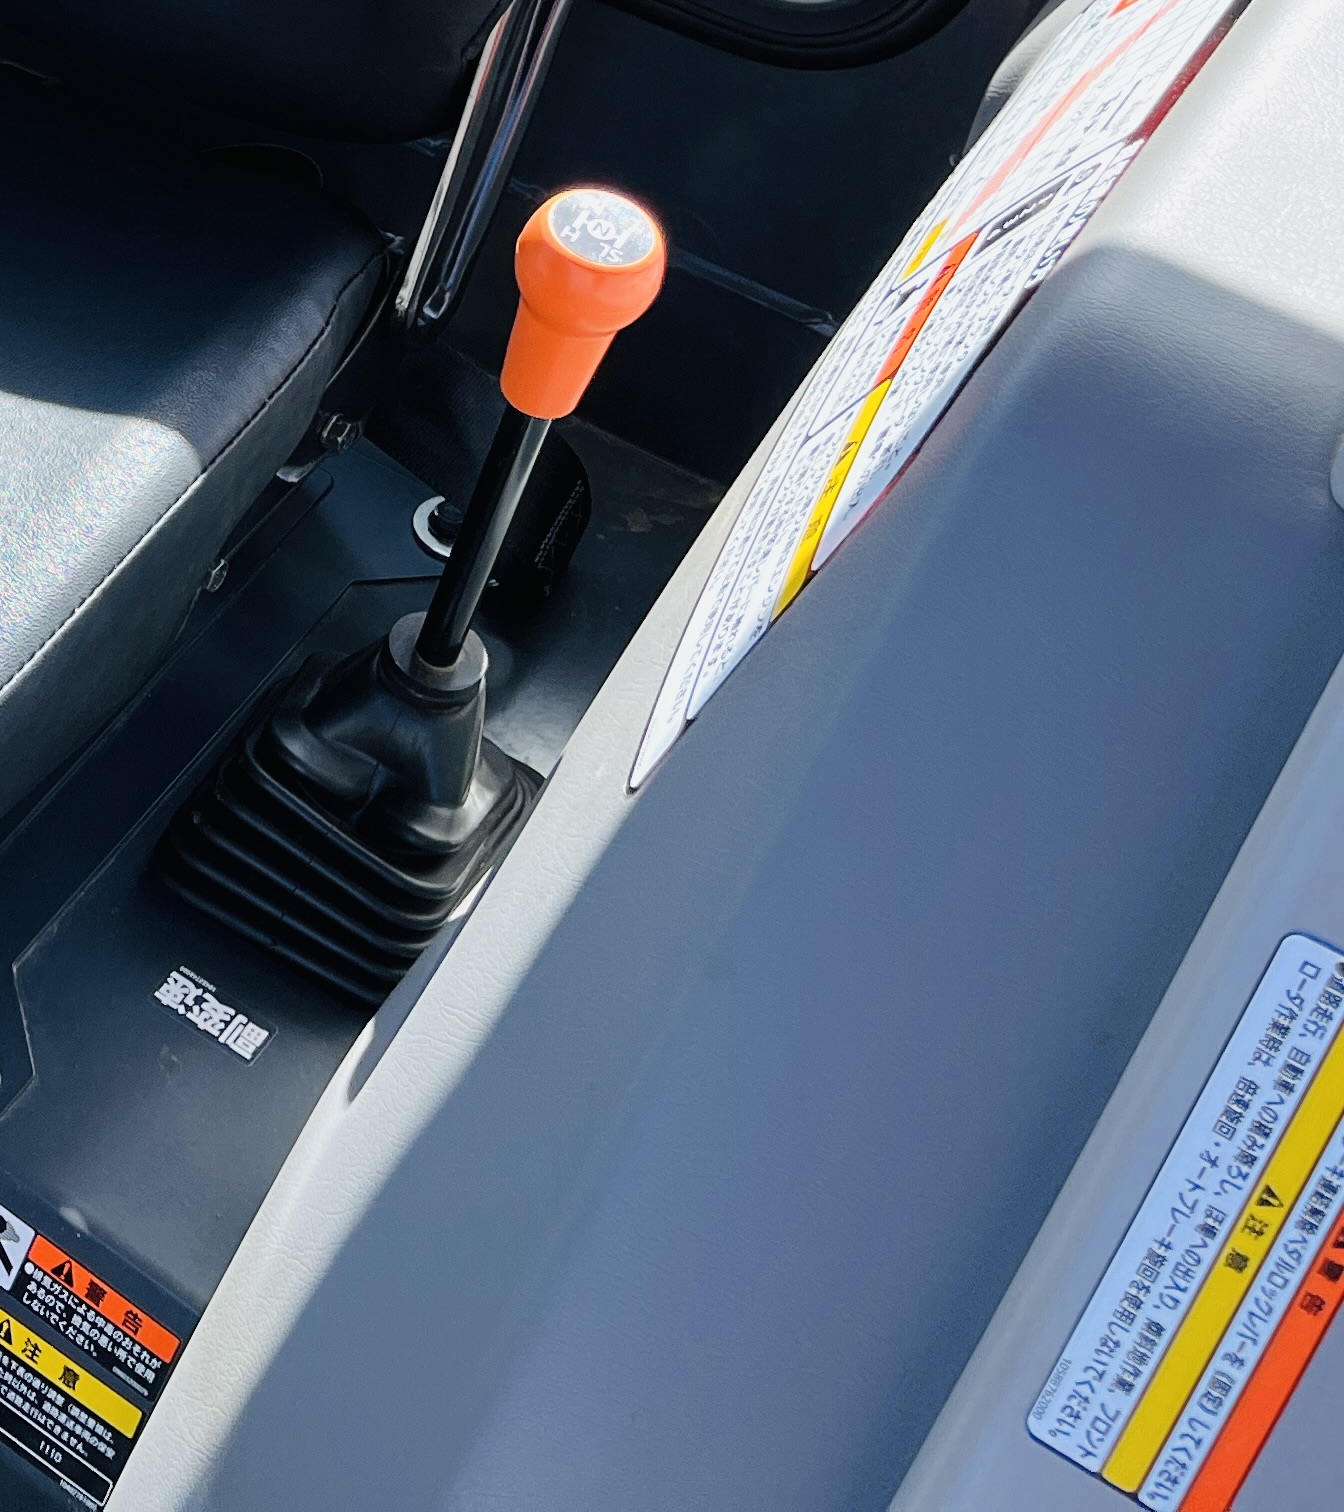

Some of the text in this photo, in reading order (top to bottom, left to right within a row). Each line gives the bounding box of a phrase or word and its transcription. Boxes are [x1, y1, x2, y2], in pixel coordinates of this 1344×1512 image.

[150, 969, 269, 1060] 副変速
[1221, 1212, 1271, 1276] 注意
[21, 1291, 98, 1357] しないでください。
[81, 1278, 146, 1336] 警告
[19, 1337, 83, 1391] 注意
